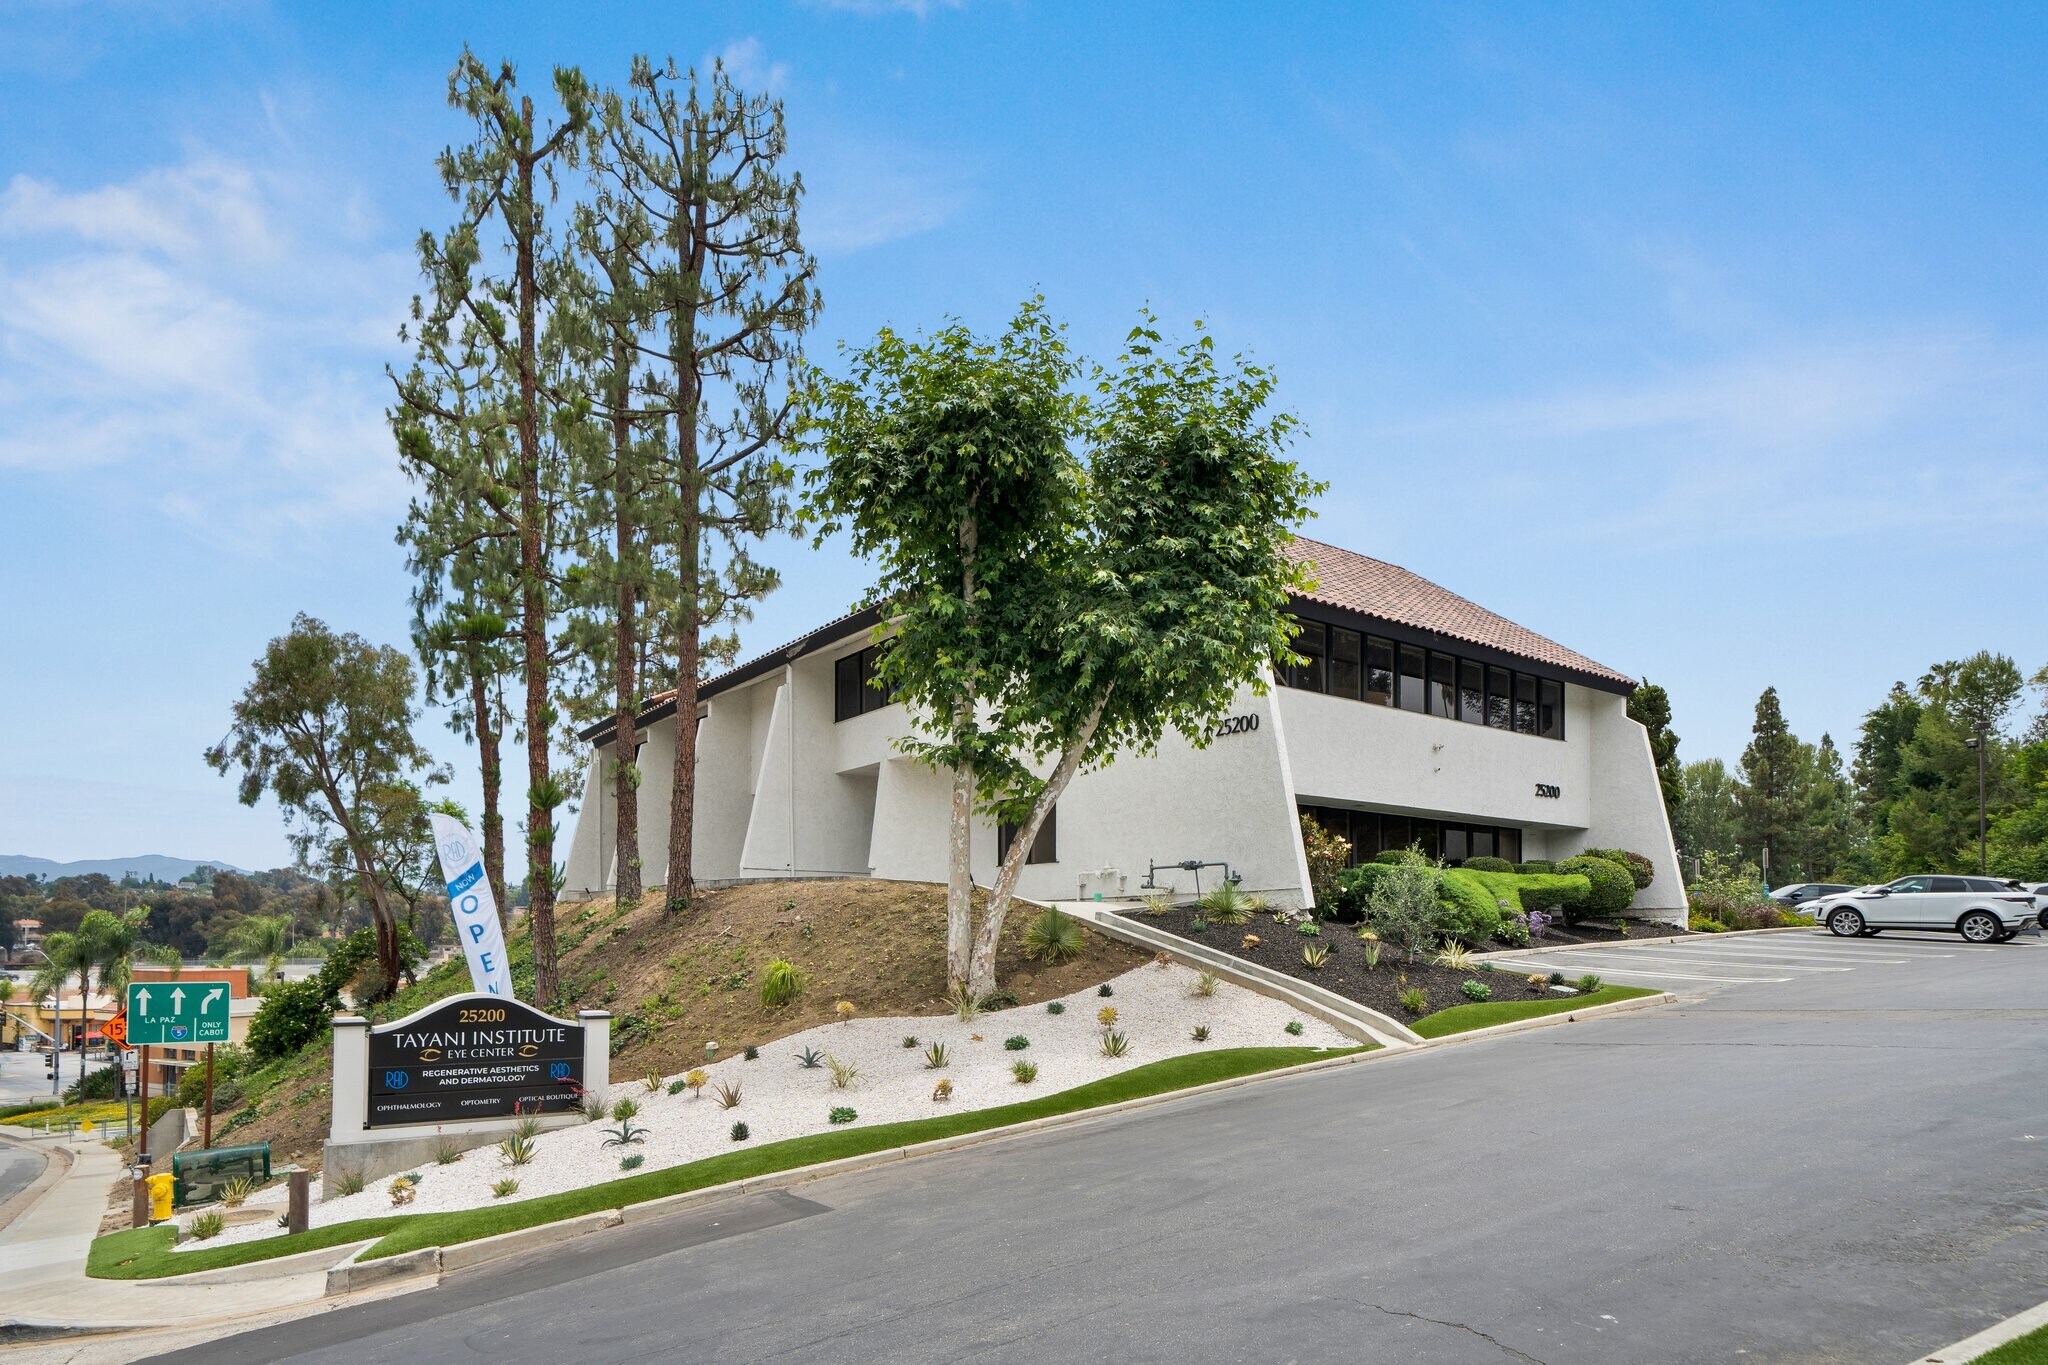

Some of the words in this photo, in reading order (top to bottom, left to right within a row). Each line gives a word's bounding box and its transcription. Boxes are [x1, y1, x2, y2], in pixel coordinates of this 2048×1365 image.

[1216, 713, 1260, 737] 25200
[1535, 783, 1560, 799] 25200
[455, 873, 475, 891] NOW
[459, 1009, 506, 1023] 25200
[393, 1031, 465, 1048] TAYANI
[473, 1028, 565, 1045] INSTITUTE
[447, 1049, 467, 1059] EYE
[470, 1047, 515, 1058] CENTER
[422, 1067, 488, 1077] REGENERATIVE
[490, 1065, 540, 1074] AESTHETICS
[439, 1078, 459, 1086] AND
[461, 1074, 526, 1084] DERMATOLOGY
[461, 1098, 501, 1107] OPTOMETRY
[519, 1094, 545, 1103] OPTICAL
[377, 1102, 442, 1112] OPHTHALMOLOGY
